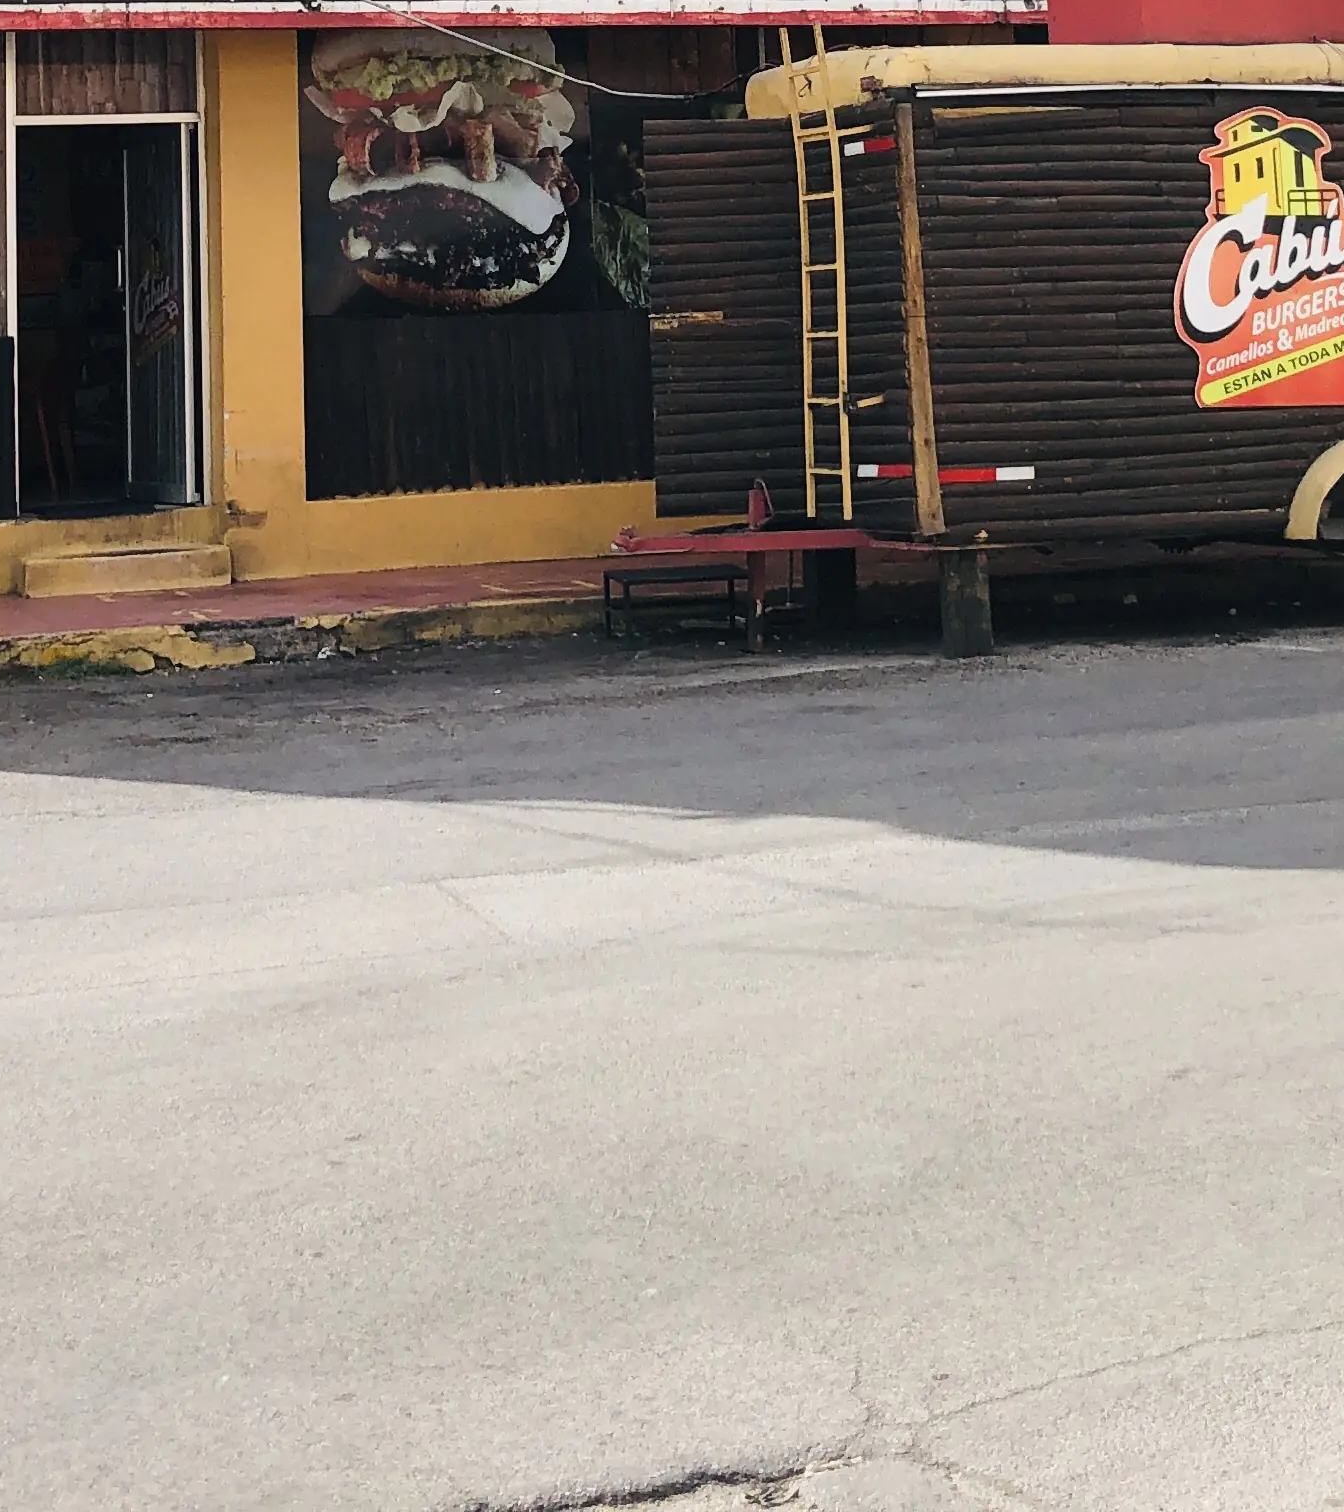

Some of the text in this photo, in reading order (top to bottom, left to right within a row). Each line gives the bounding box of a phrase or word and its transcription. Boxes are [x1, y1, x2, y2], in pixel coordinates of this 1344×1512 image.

[1206, 339, 1274, 375] Camellos
[1277, 328, 1294, 352] &
[1222, 367, 1272, 395] ESTÁN
[1276, 363, 1287, 376] A
[1287, 346, 1331, 370] TODA
